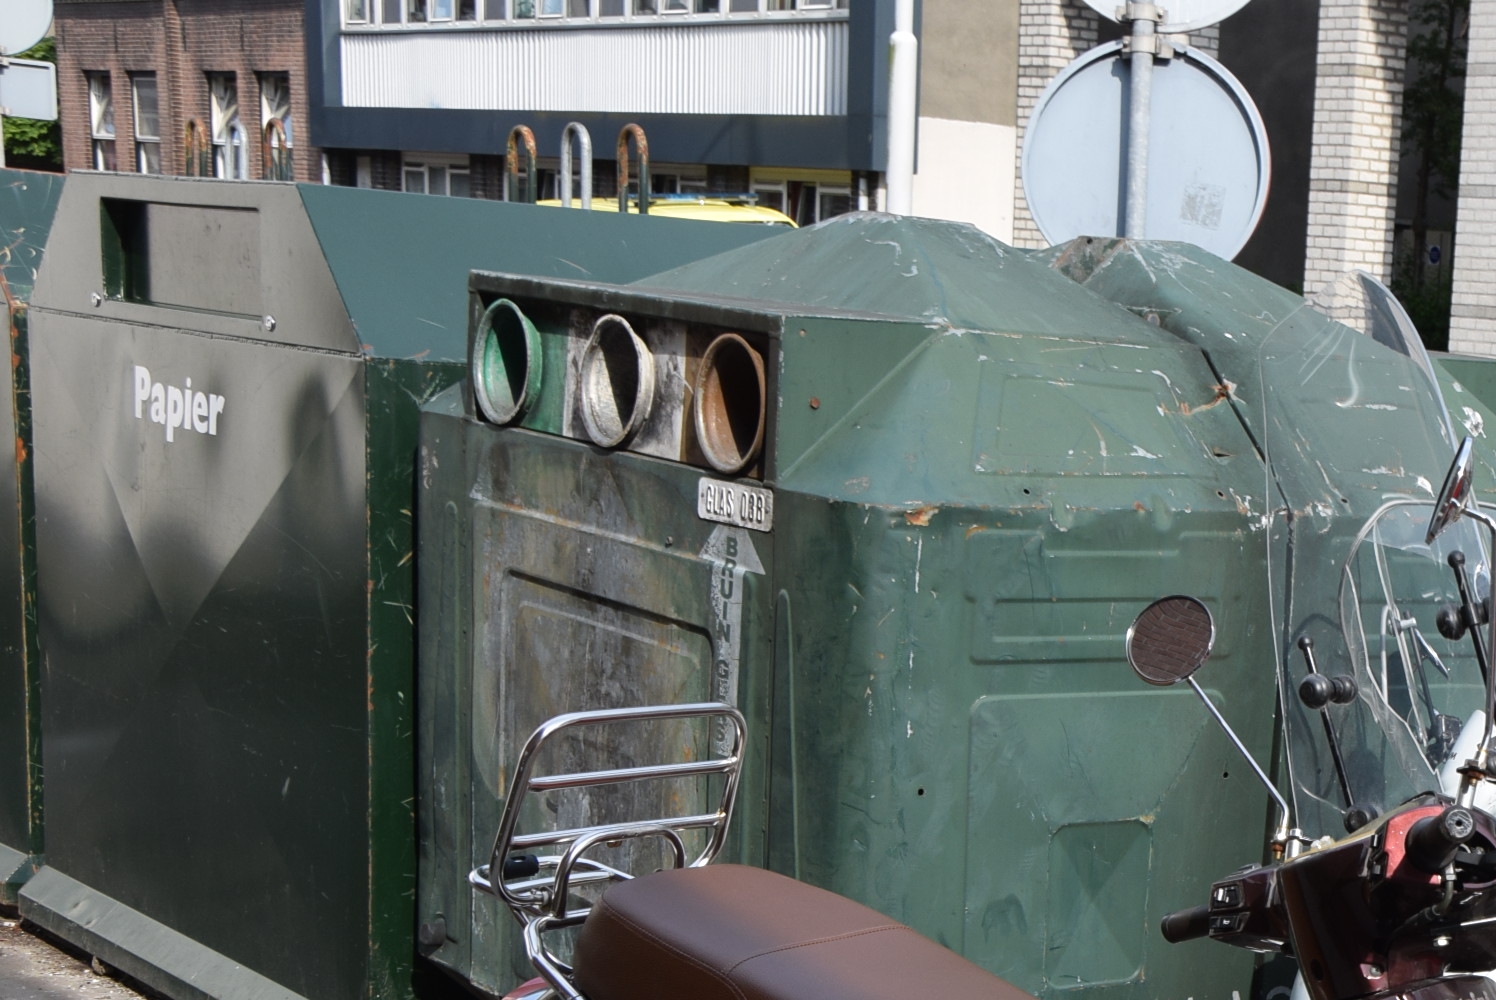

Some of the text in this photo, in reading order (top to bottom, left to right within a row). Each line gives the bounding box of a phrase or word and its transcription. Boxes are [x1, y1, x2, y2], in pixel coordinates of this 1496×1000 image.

[134, 364, 226, 443] Papier
[706, 484, 765, 524] GLAS 038
[716, 536, 739, 643] BRUIN
